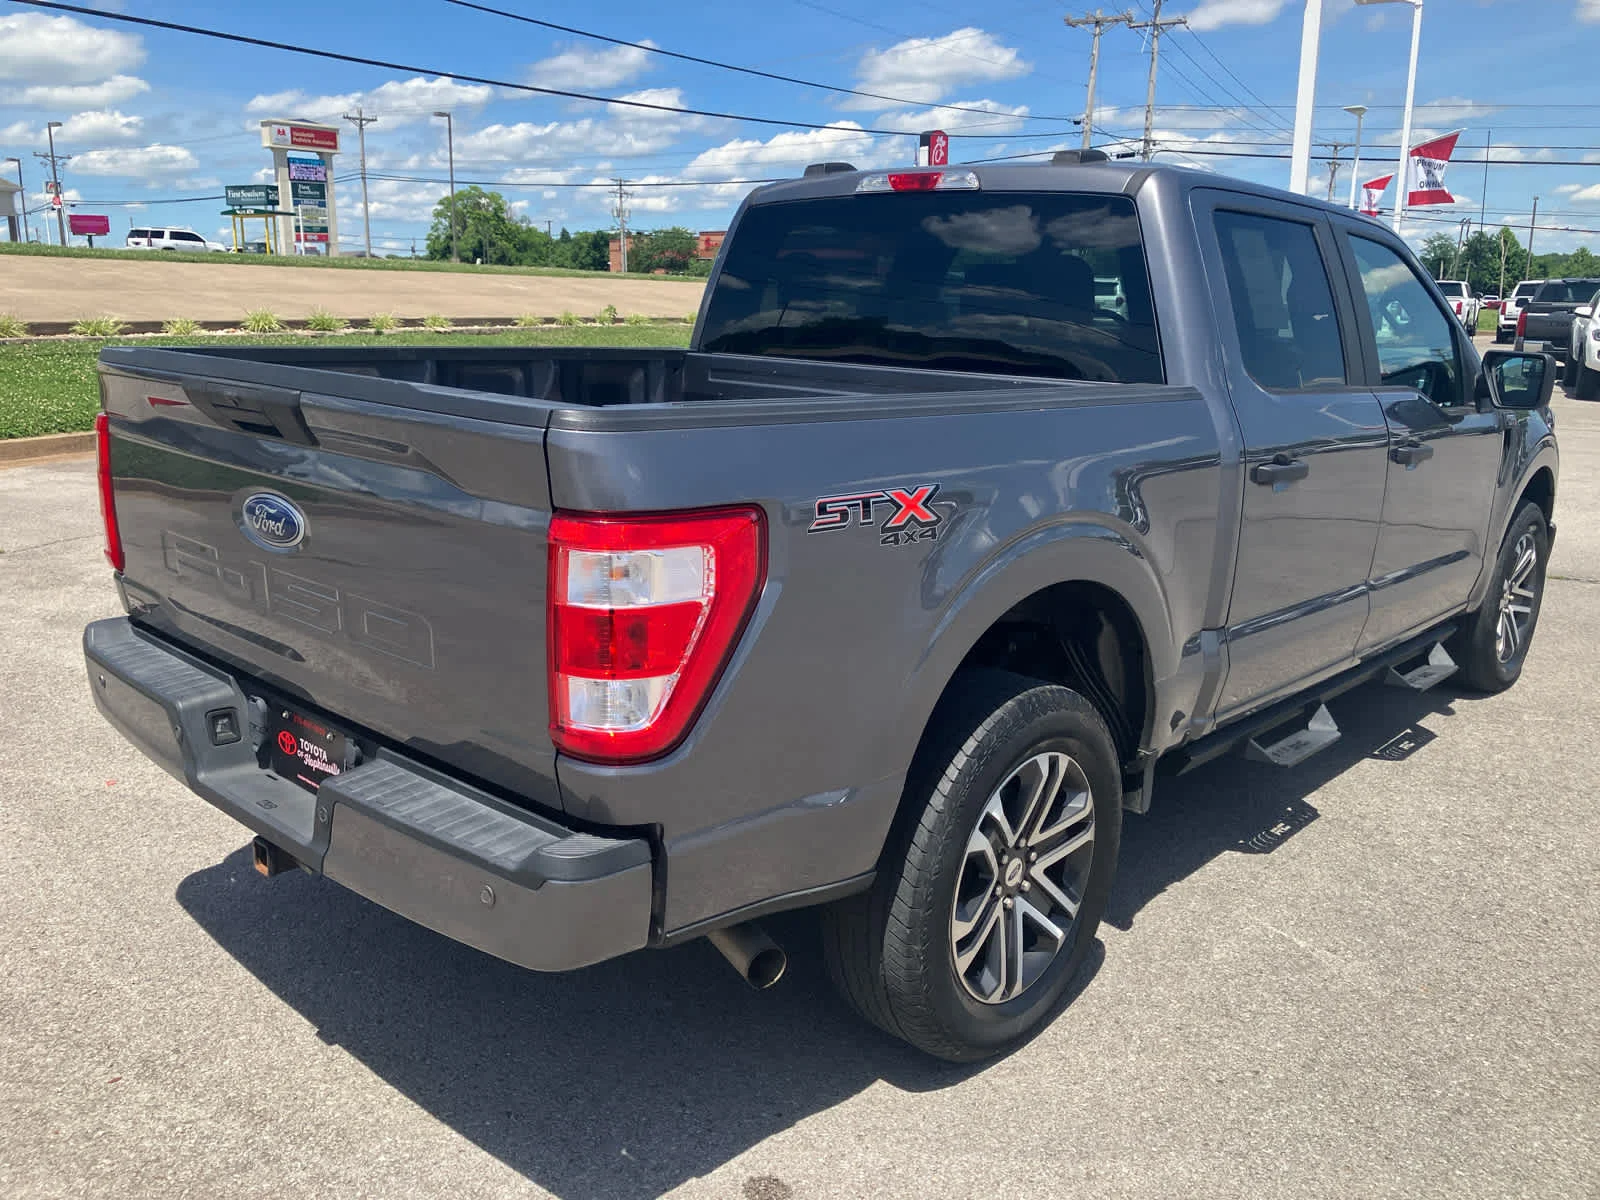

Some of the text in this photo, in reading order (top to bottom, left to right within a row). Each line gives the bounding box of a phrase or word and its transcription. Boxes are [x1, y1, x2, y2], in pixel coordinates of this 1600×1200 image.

[252, 503, 286, 537] Ford
[807, 483, 944, 534] STX
[299, 738, 328, 762] TOYOTA
